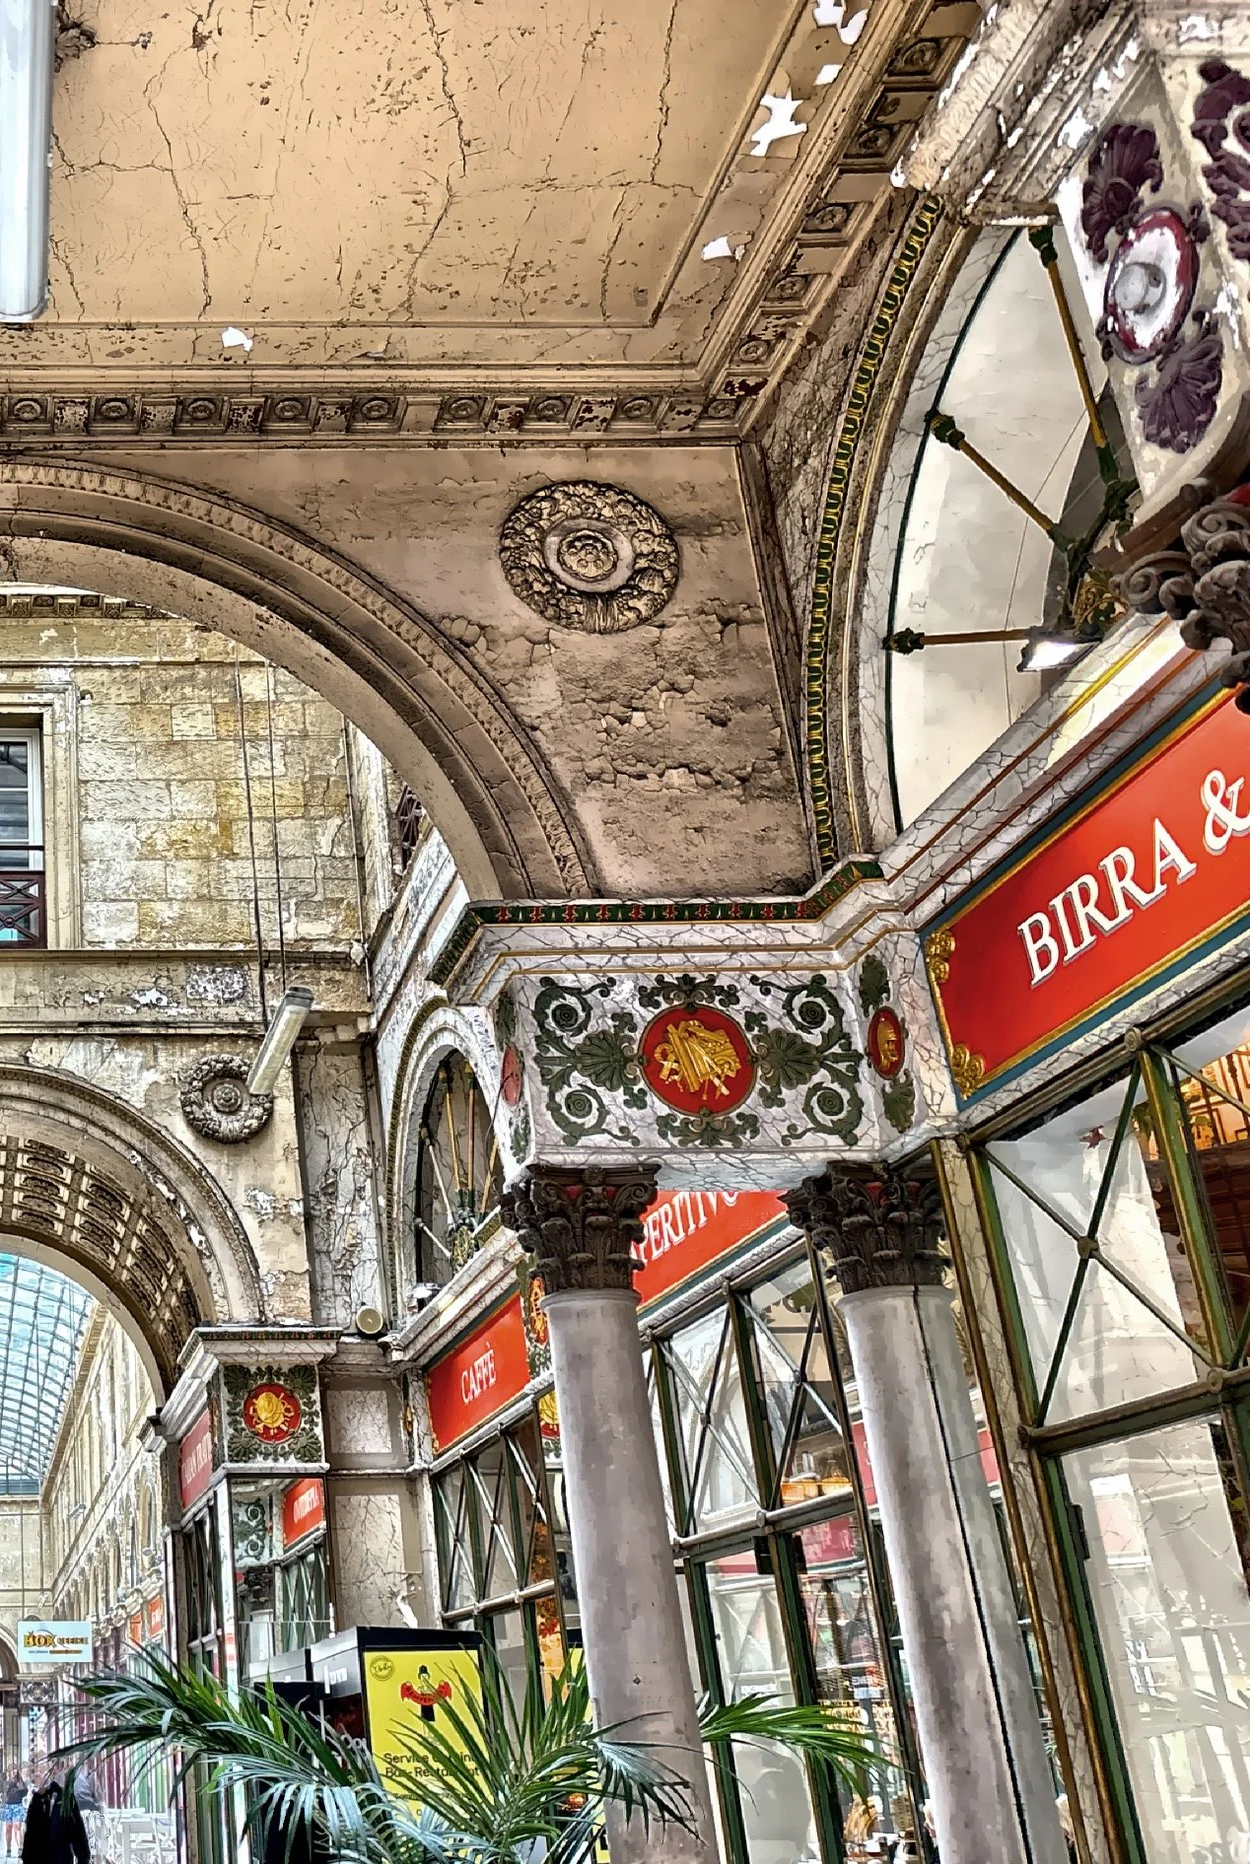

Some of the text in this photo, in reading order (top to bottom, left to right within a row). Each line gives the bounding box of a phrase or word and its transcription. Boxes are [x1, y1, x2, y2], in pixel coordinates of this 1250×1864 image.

[1017, 769, 1250, 988] BIRRA &
[461, 1342, 497, 1404] CAFFÈ
[24, 1633, 56, 1648] BOX
